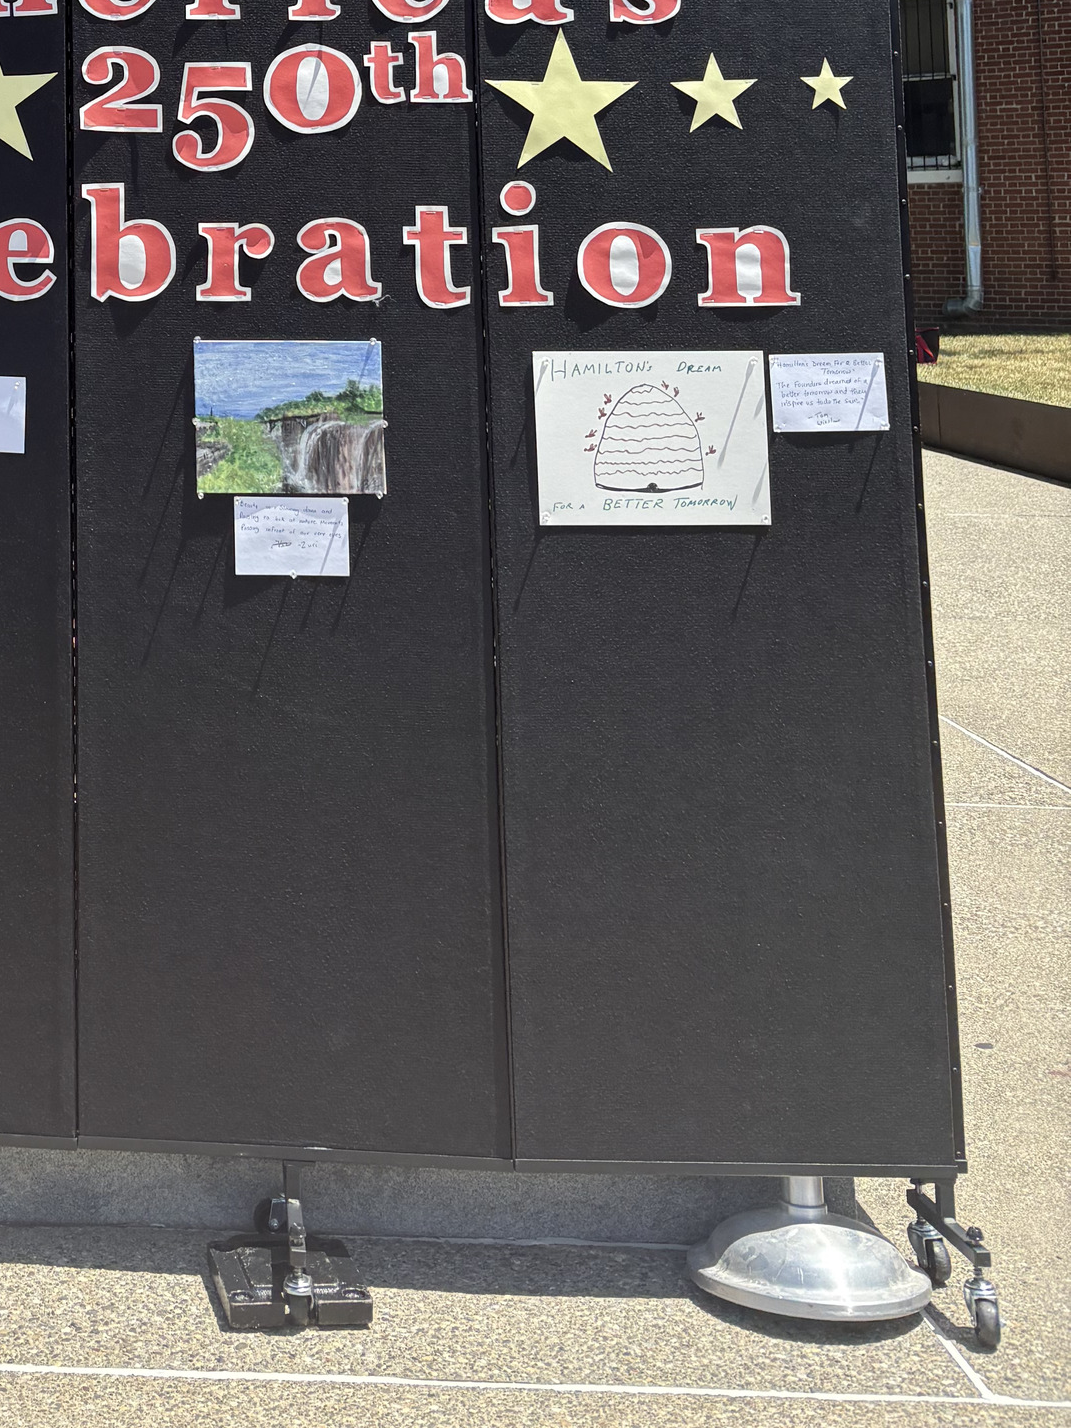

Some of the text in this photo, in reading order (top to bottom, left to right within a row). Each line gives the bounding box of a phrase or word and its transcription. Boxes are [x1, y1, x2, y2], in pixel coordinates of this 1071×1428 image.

[80, 31, 473, 171] 250th
[676, 361, 723, 374] DREAM
[603, 498, 664, 511] BETTER
